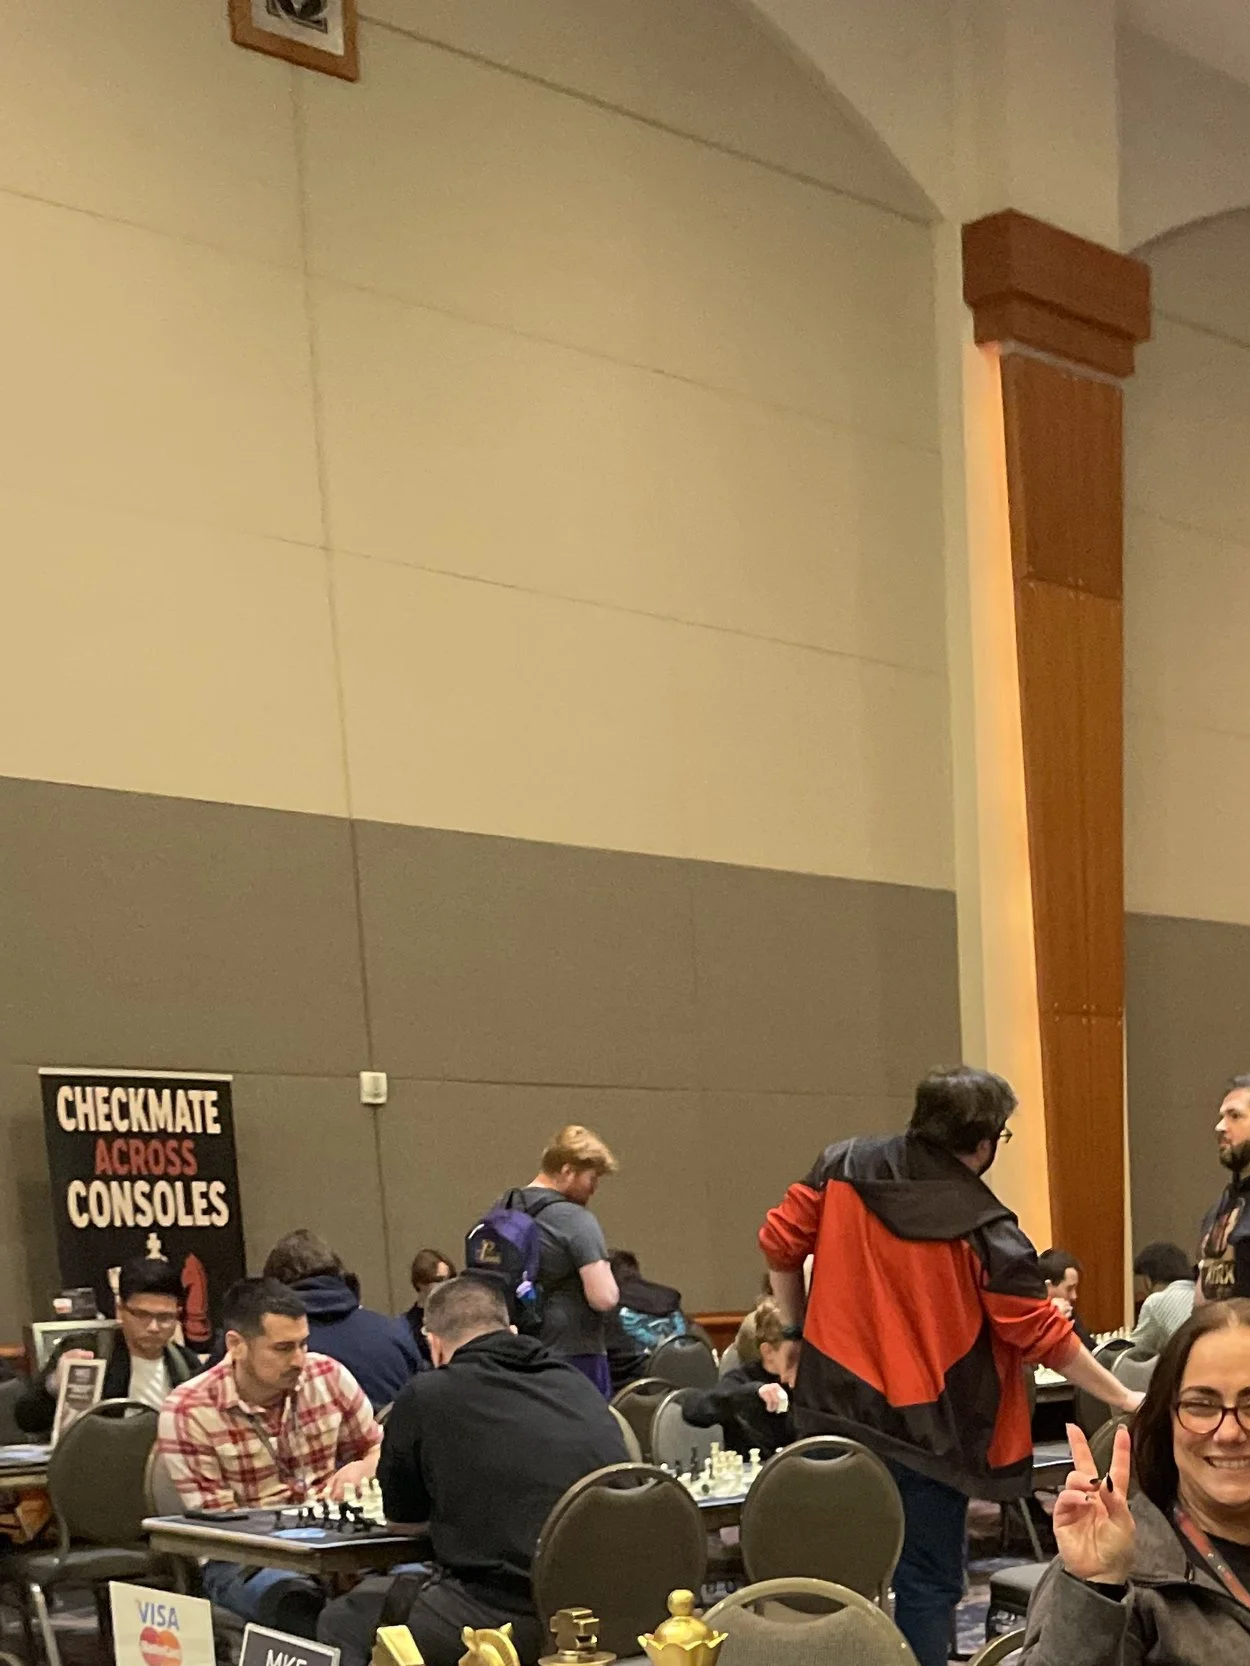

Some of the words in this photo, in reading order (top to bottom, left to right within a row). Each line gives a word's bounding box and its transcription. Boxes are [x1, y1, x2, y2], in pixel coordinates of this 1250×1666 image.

[57, 1085, 222, 1134] CHECKMATE
[95, 1138, 198, 1175] ACROSS
[67, 1180, 230, 1228] CONSOLES
[138, 1600, 180, 1631] VISA
